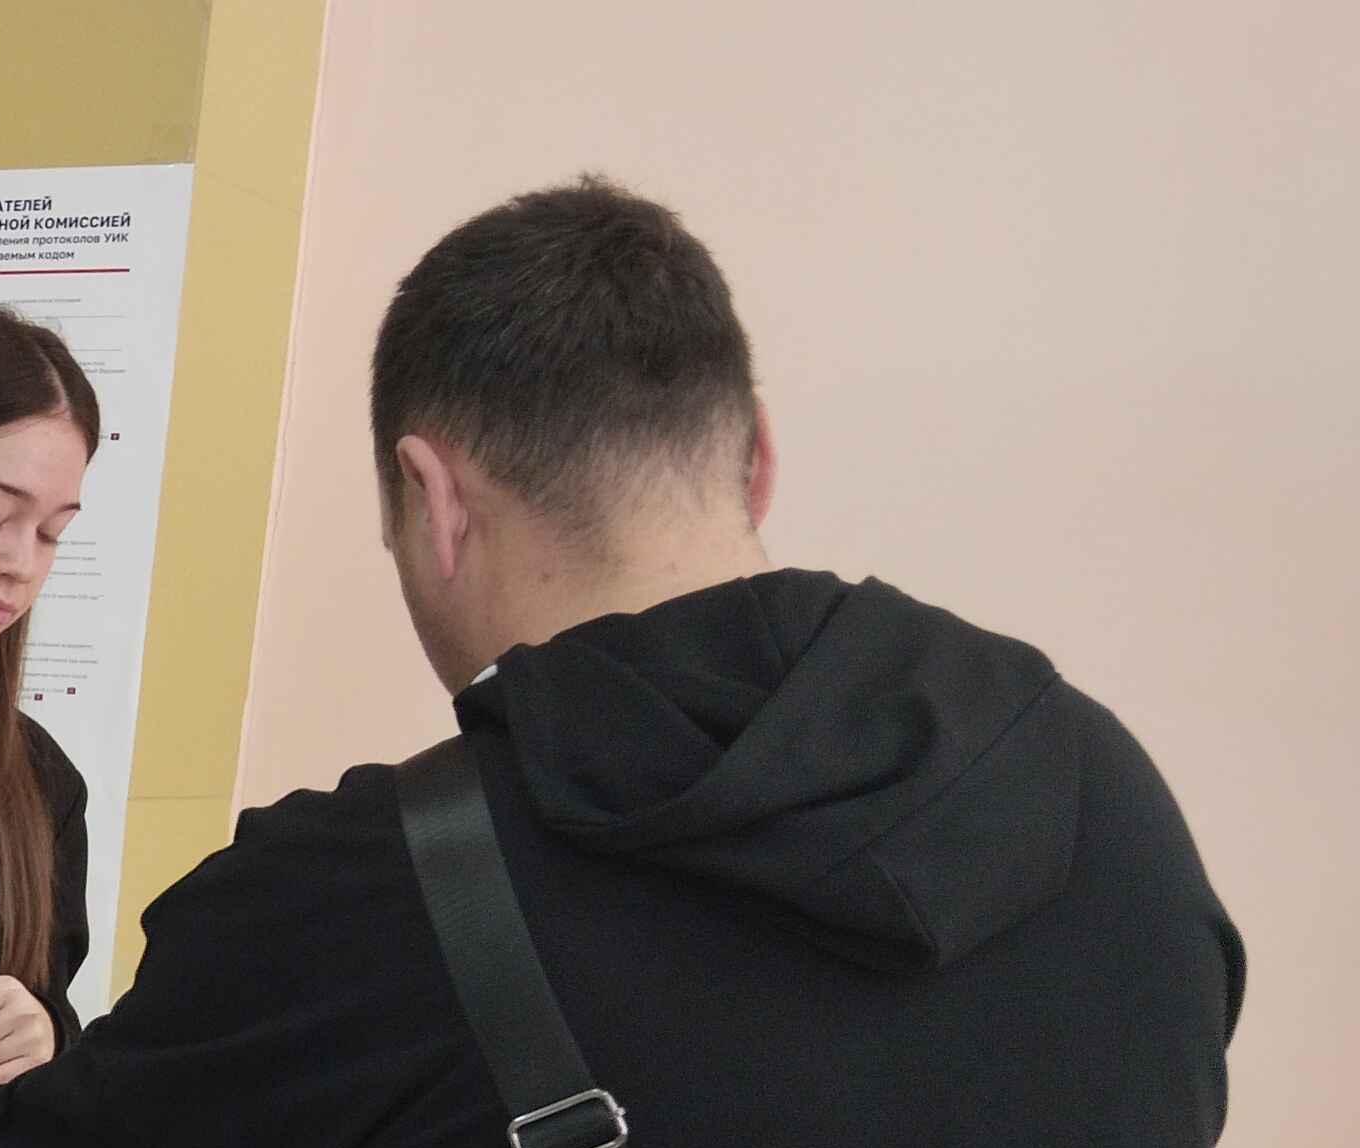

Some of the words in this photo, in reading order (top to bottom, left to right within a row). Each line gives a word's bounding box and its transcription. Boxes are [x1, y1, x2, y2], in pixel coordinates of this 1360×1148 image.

[33, 211, 132, 230] КОМИССИЕЙ
[32, 235, 101, 247] протоколов
[103, 232, 130, 243] УИК
[38, 250, 75, 261] кодом
